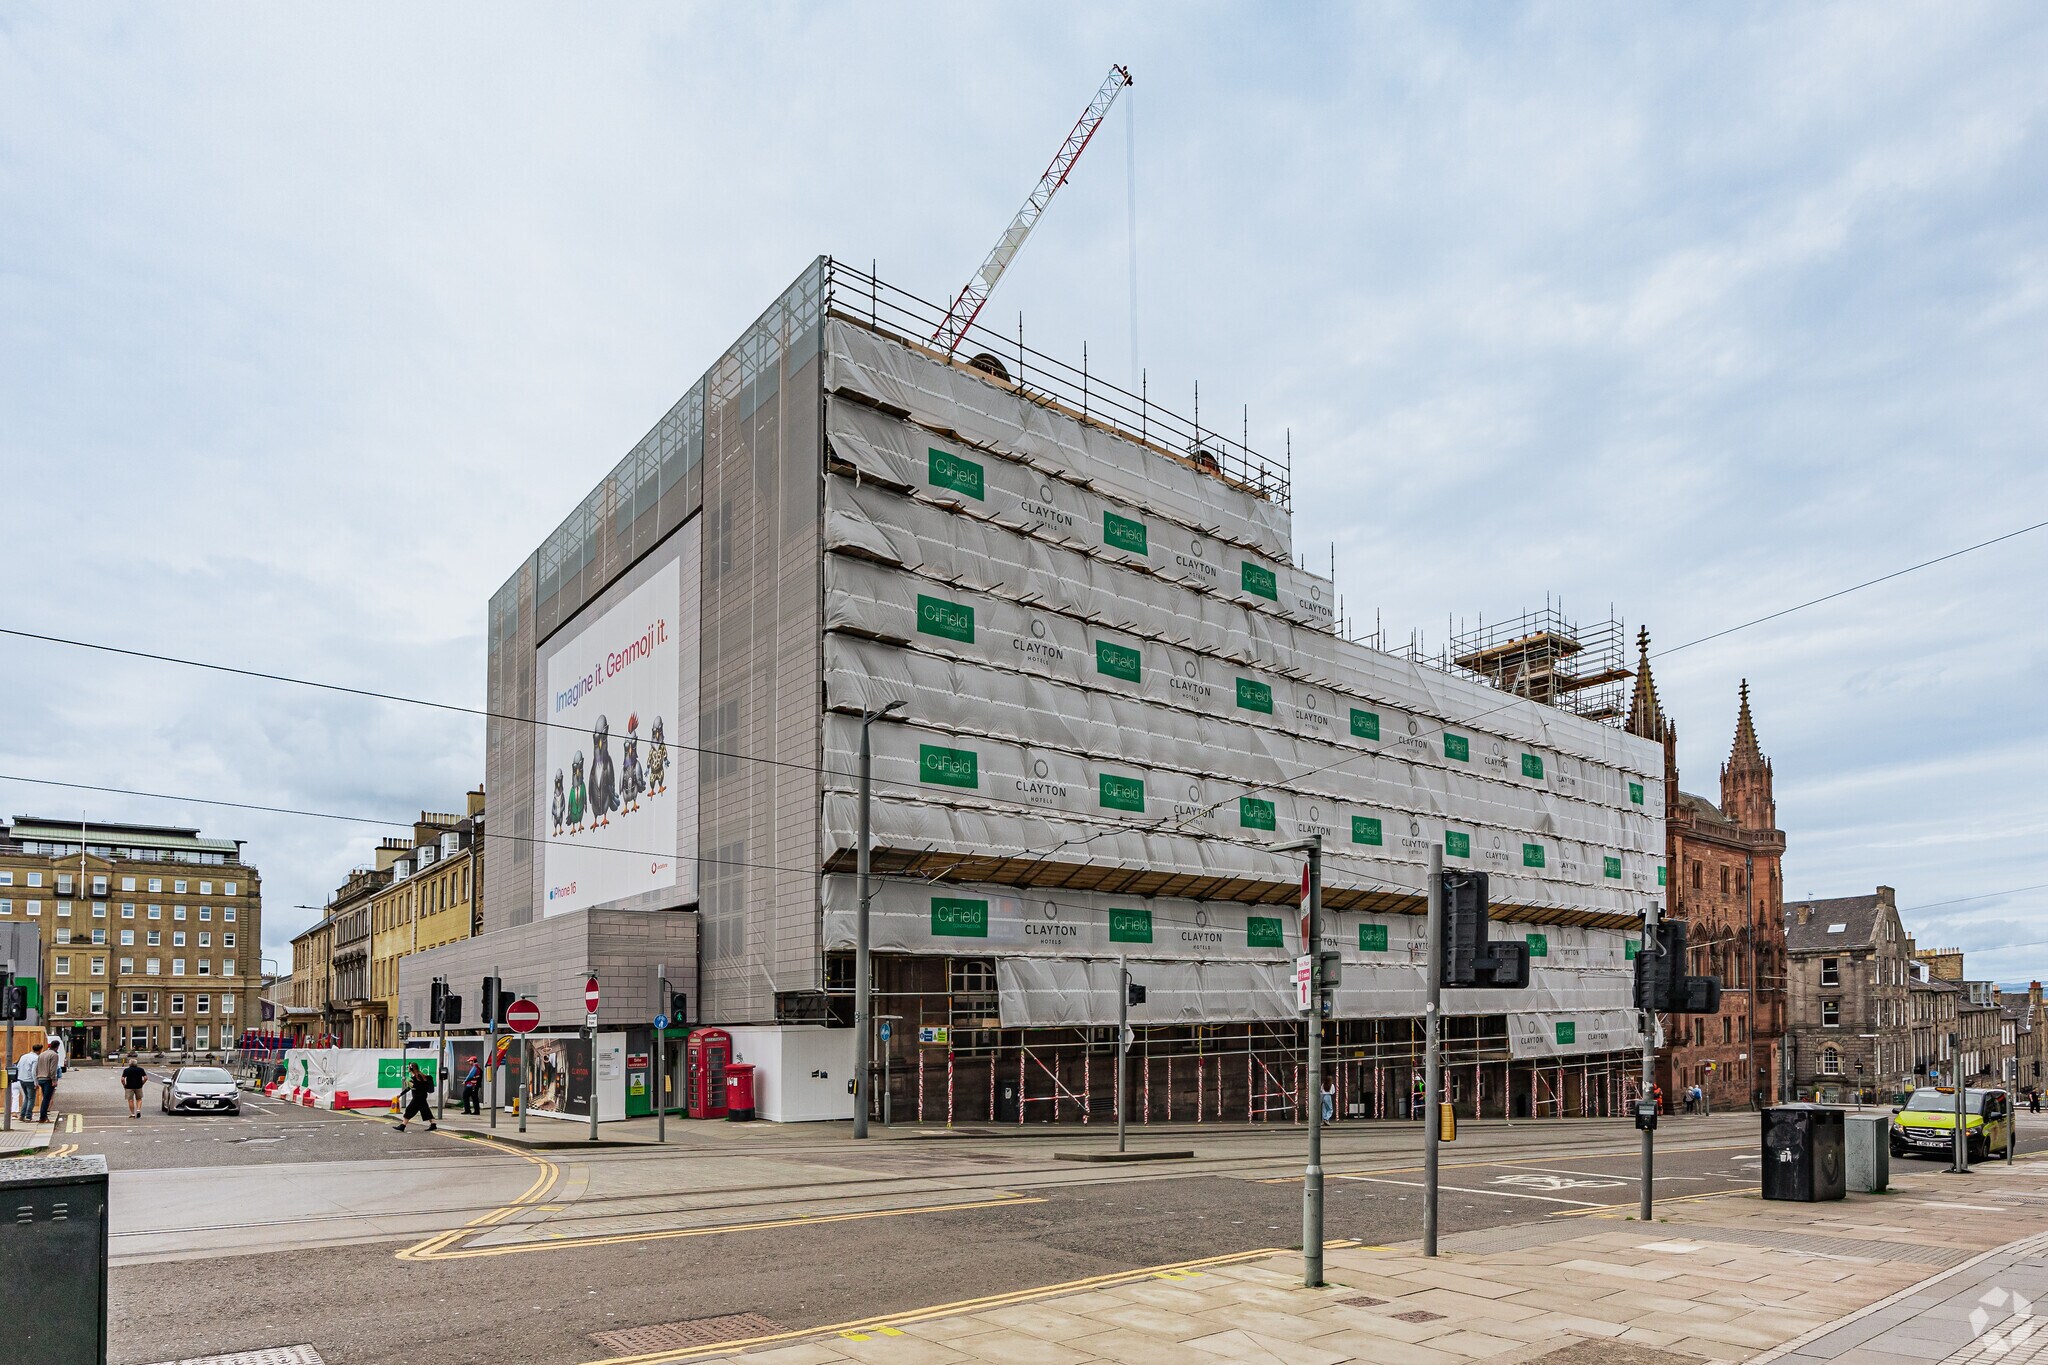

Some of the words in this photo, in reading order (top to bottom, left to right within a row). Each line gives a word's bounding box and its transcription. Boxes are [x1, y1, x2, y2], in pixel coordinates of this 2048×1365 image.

[1021, 501, 1072, 526] CLAYTON
[1176, 556, 1216, 577] CLAYTON
[1300, 600, 1332, 618] CLAYTON
[1013, 639, 1064, 660] CLAYTON
[556, 674, 593, 713] Imagine
[595, 663, 604, 687] it.
[606, 624, 654, 678] Genmoji
[657, 619, 668, 645] it.
[1028, 656, 1049, 666] HOTELS
[1170, 678, 1211, 696] CLAYTON
[1296, 711, 1328, 726] CLAYTON
[1398, 736, 1428, 749] CLAYTON
[1016, 780, 1066, 797] CLAYTON
[1030, 796, 1052, 804] HOTELS
[1174, 804, 1214, 819] CLAYTON
[1298, 824, 1331, 836] CLAYTON
[1402, 839, 1429, 849] CLAYTON
[1486, 851, 1509, 861] CLAYTON
[554, 886, 570, 899] iPhone
[571, 882, 576, 894] 16
[1025, 924, 1077, 936] CLAYTON
[1181, 932, 1222, 942] CLAYTON
[1521, 1036, 1543, 1044] CLAYTON
